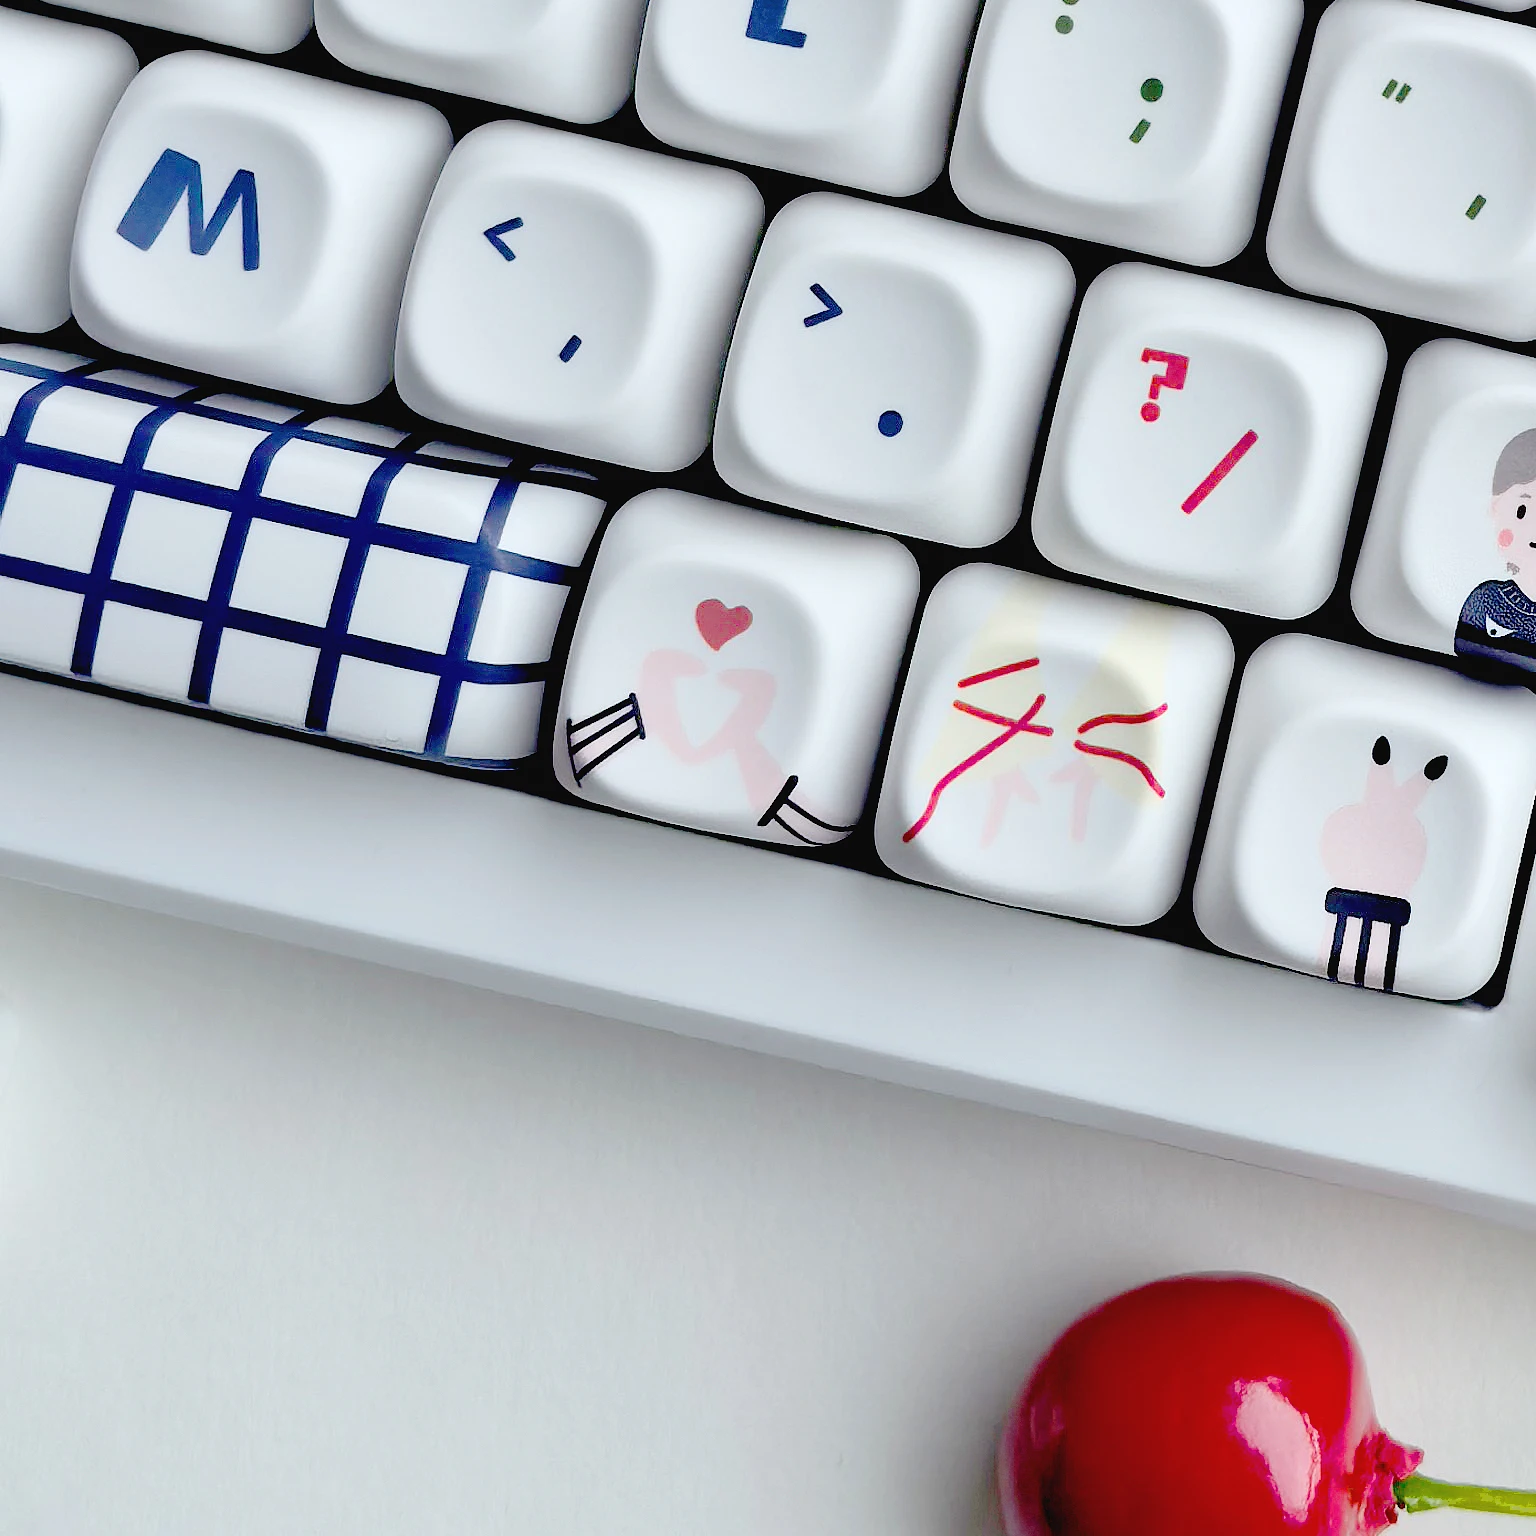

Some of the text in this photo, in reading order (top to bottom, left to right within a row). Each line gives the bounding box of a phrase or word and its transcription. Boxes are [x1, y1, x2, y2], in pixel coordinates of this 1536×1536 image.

[117, 148, 260, 271] M
[483, 217, 524, 262] <
[804, 283, 843, 328] >
[1140, 348, 1189, 422] ?
[1181, 429, 1258, 514] /
